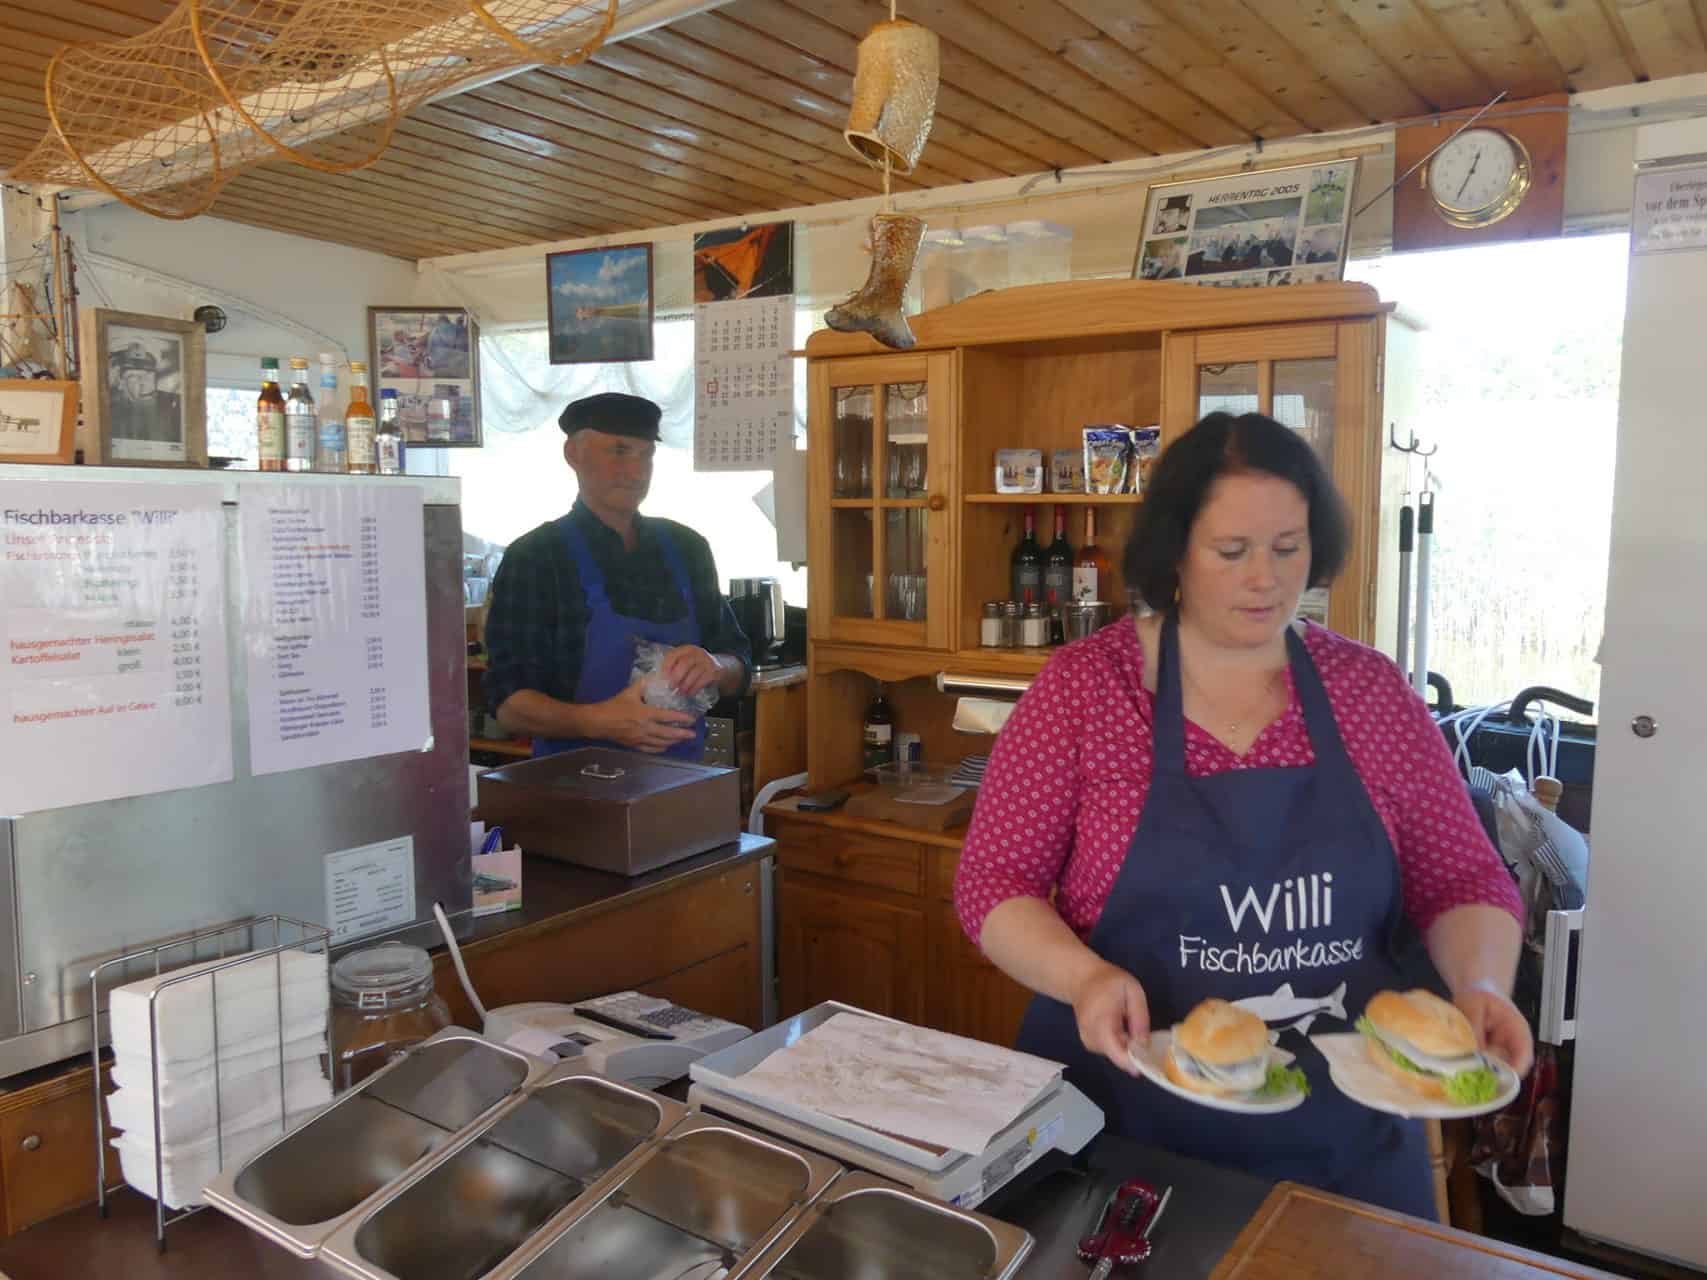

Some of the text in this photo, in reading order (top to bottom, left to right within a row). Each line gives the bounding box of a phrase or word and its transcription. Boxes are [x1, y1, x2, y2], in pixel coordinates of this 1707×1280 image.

[1208, 183, 1300, 203] HERRENTAG 2005
[4, 508, 126, 525] Fischbarkasse
[1219, 871, 1333, 934] Willi
[1179, 934, 1364, 975] Fischbarkasse
